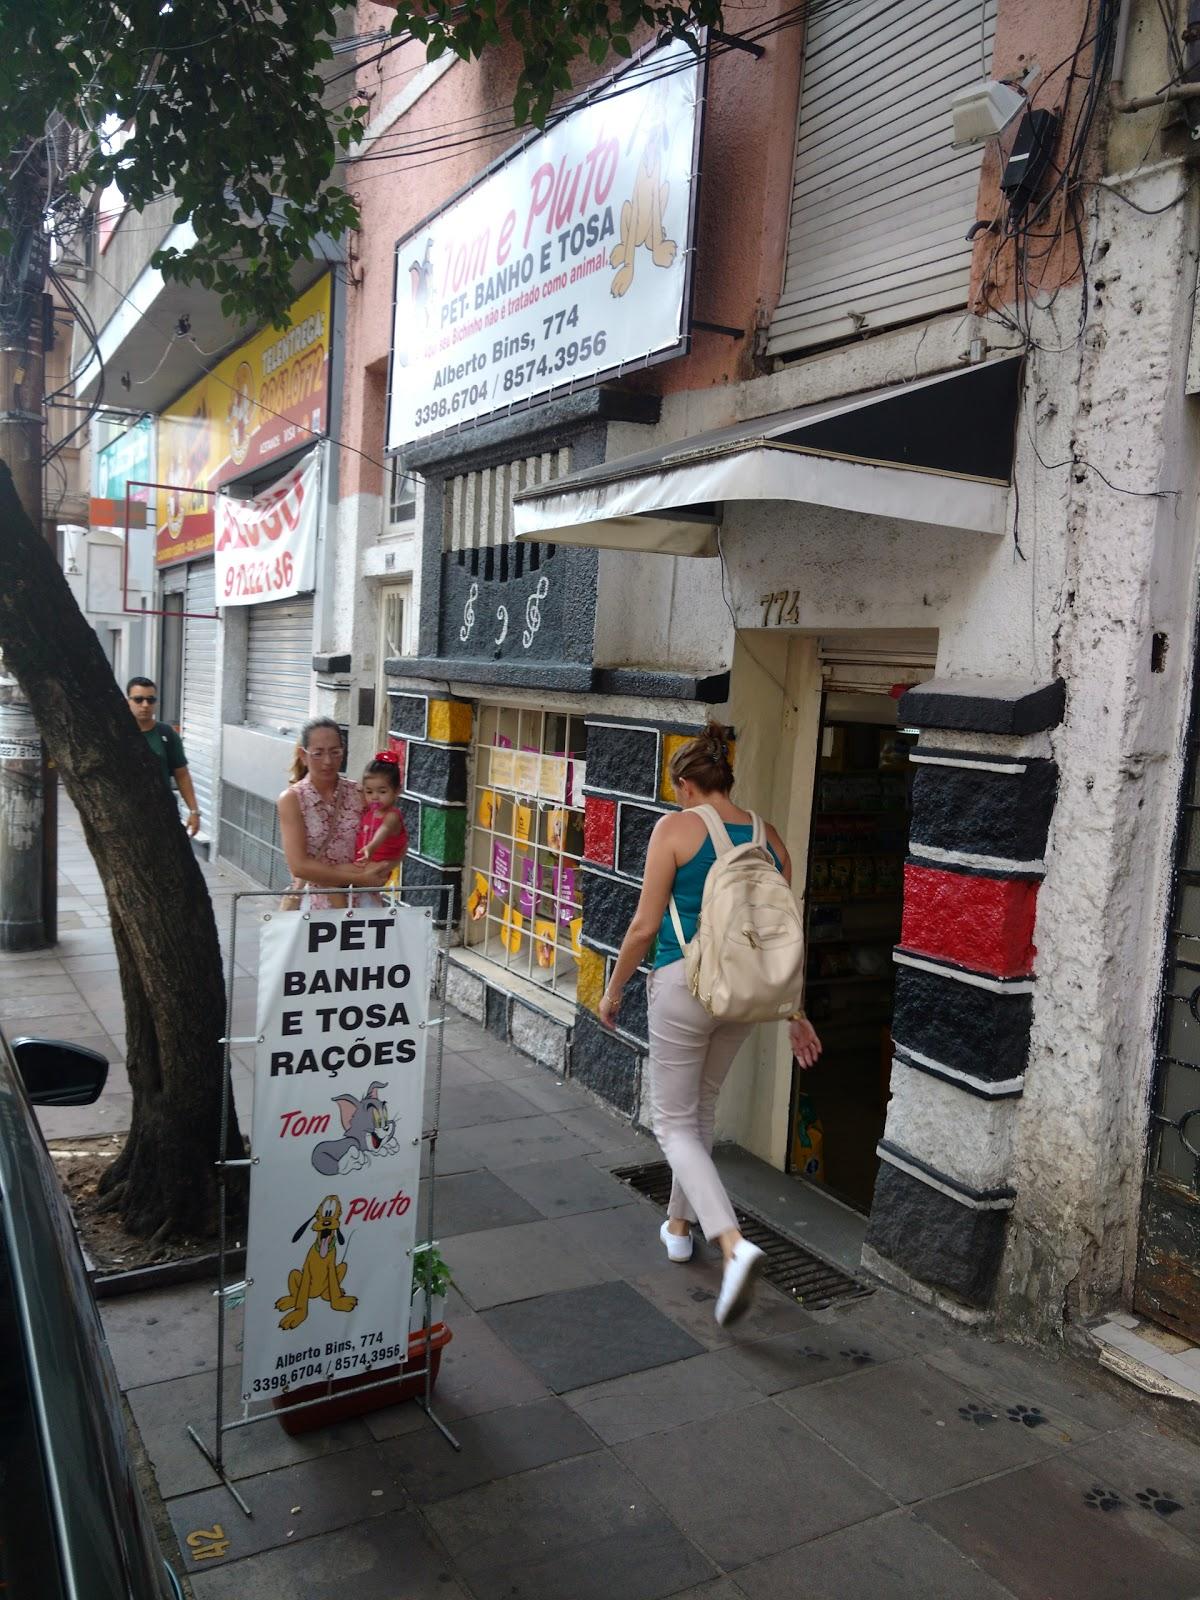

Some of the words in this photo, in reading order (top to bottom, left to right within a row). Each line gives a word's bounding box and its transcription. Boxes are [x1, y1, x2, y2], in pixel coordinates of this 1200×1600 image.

[496, 209, 517, 264] e
[524, 132, 619, 249] Pluto
[475, 253, 534, 310] BANHO
[540, 242, 551, 274] E
[558, 206, 615, 265] TOSA
[507, 285, 540, 316] tratado
[542, 272, 567, 298] como
[569, 246, 608, 284] animal.
[433, 349, 486, 391] Alberto
[492, 331, 536, 364] Bins,
[543, 304, 579, 340] 774
[415, 384, 488, 428] 3398.6704
[503, 330, 608, 392] 8574.3956
[308, 918, 395, 953] PET
[283, 963, 411, 997] BANHO
[281, 1010, 303, 1036] E
[316, 1002, 410, 1033] TOSA
[270, 1036, 416, 1078] RAÇÕES
[280, 1110, 333, 1138] Tom
[344, 1190, 411, 1225] Pluto
[253, 1362, 323, 1393] 3398.6704
[335, 1344, 401, 1371] 8574.3956
[275, 1347, 321, 1370] Alberto
[360, 1331, 384, 1348] 774
